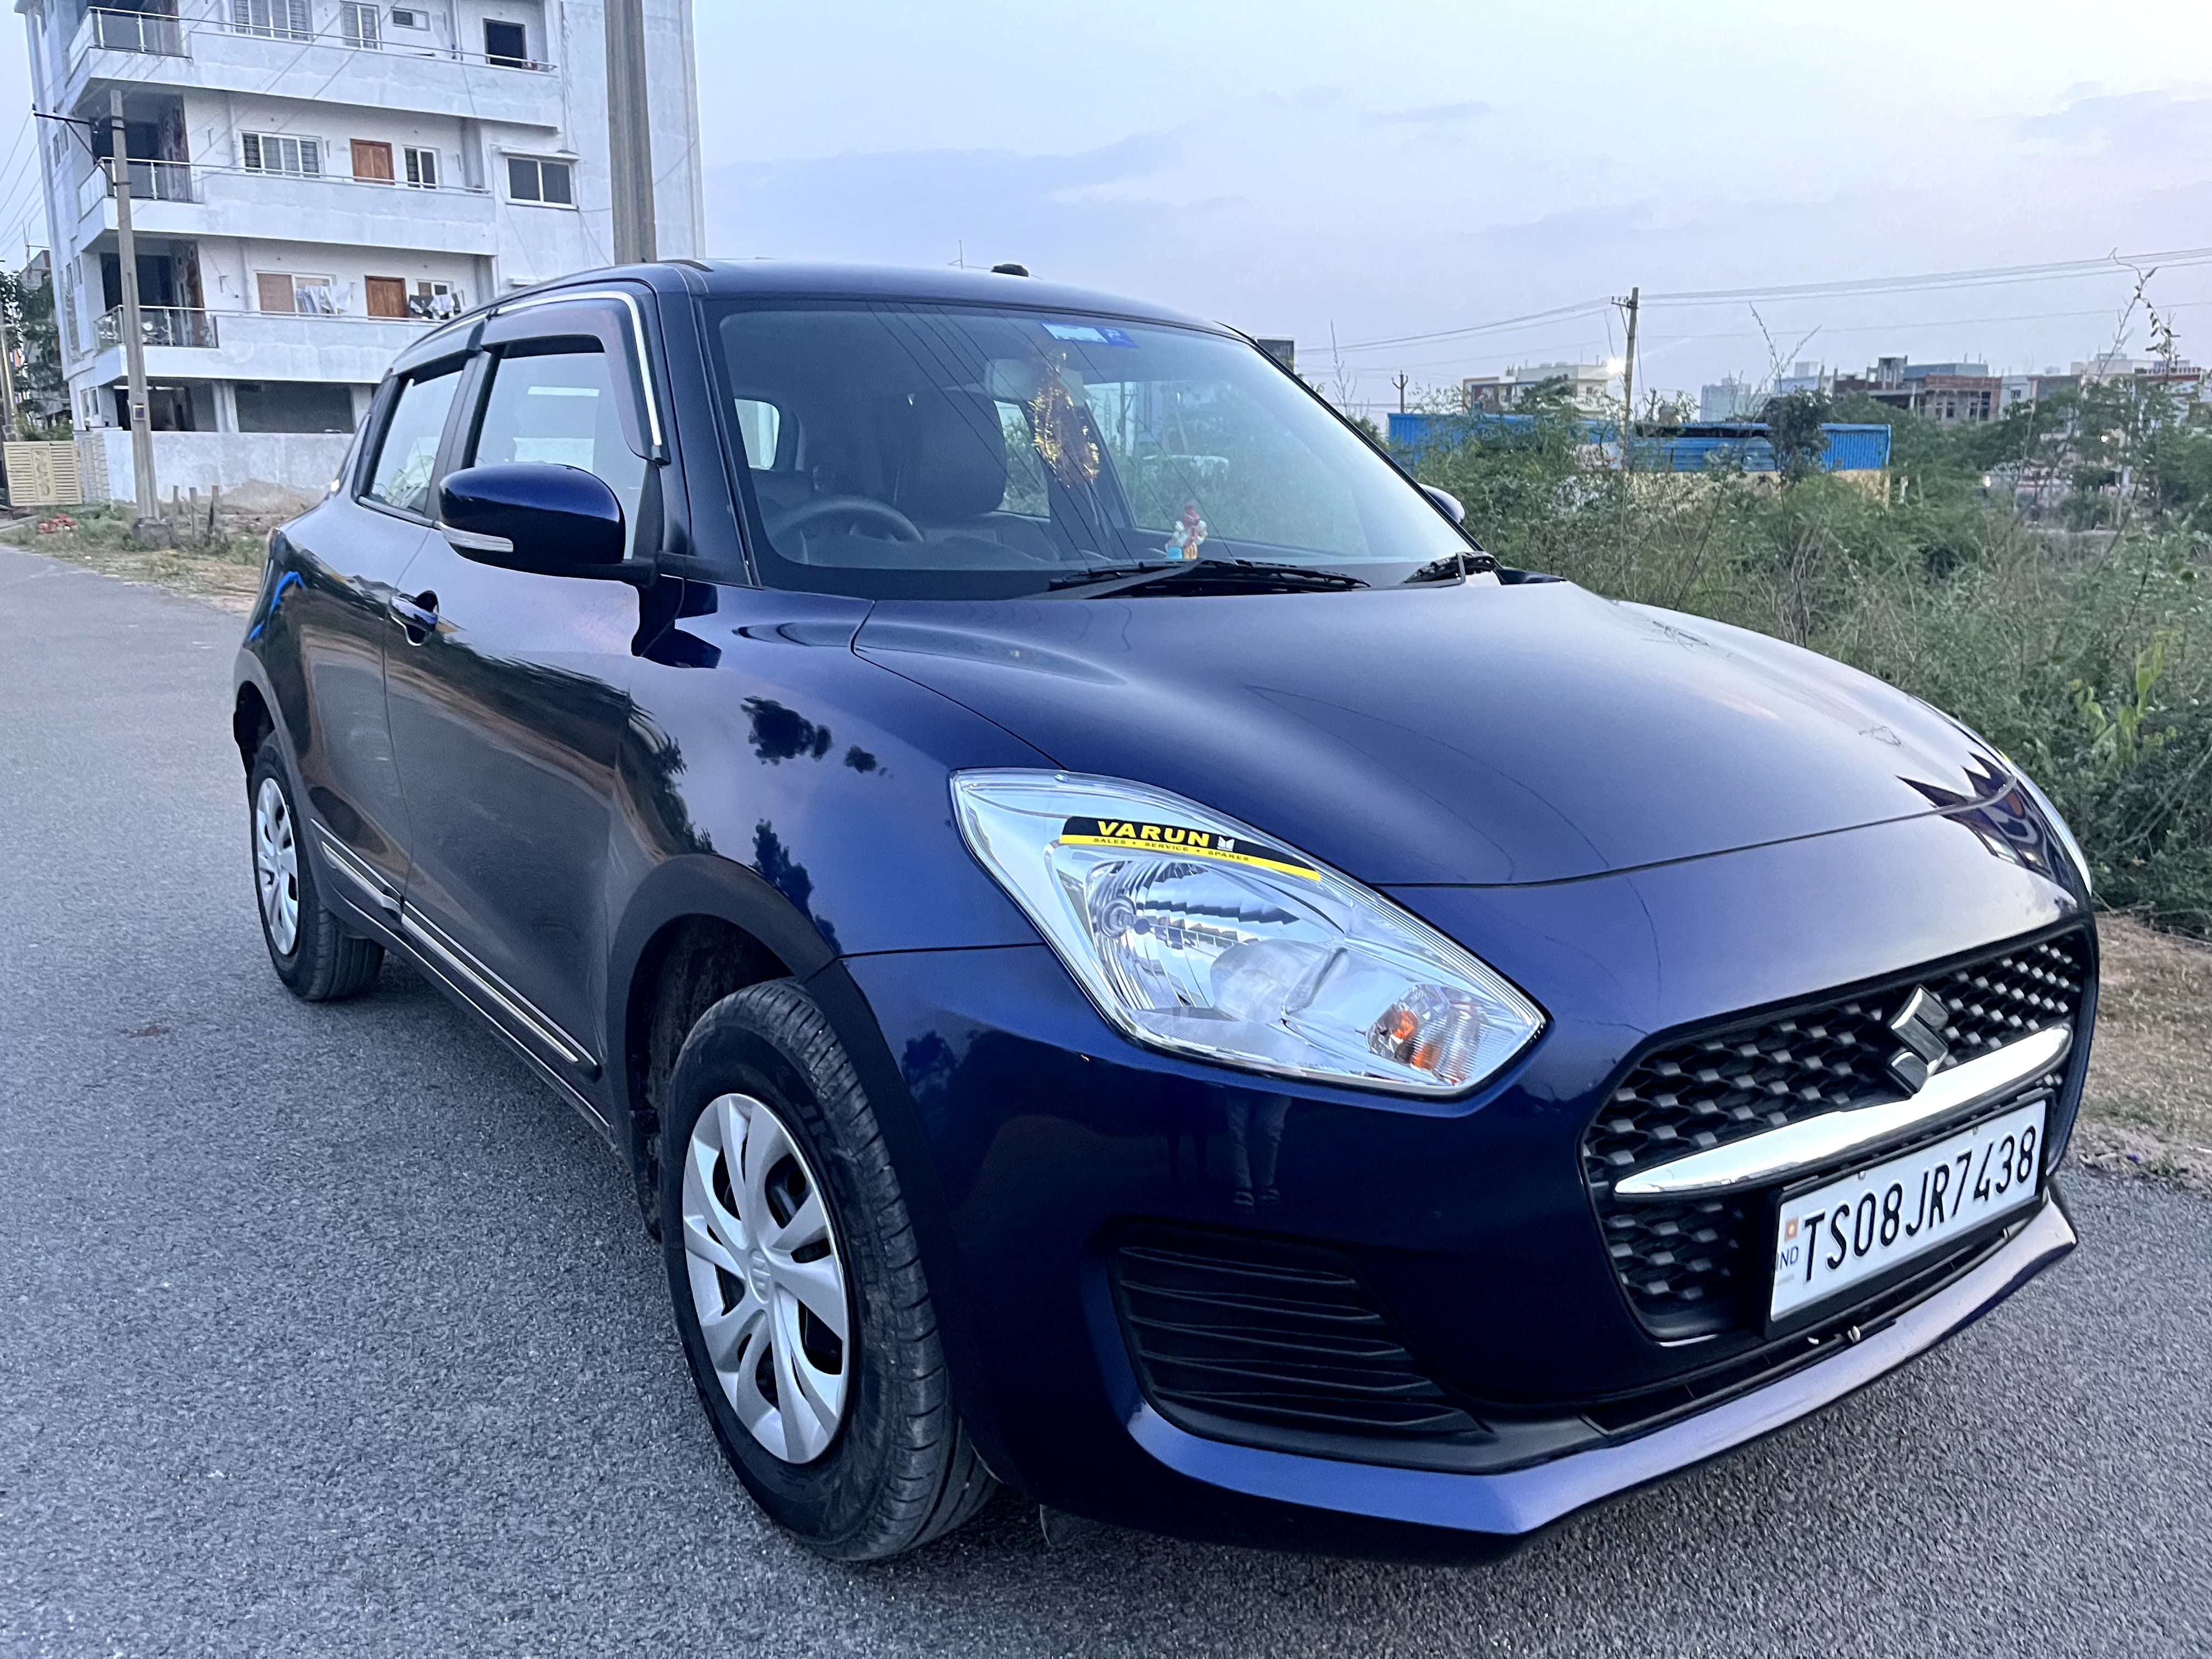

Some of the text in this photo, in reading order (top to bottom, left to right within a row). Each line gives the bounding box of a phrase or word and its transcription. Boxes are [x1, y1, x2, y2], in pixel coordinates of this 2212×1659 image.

[1097, 821, 1210, 848] VARUN
[1144, 842, 1189, 852] SERVICE
[1208, 850, 1249, 861] SPARES
[1804, 1125, 2036, 1282] TS08JR7438
